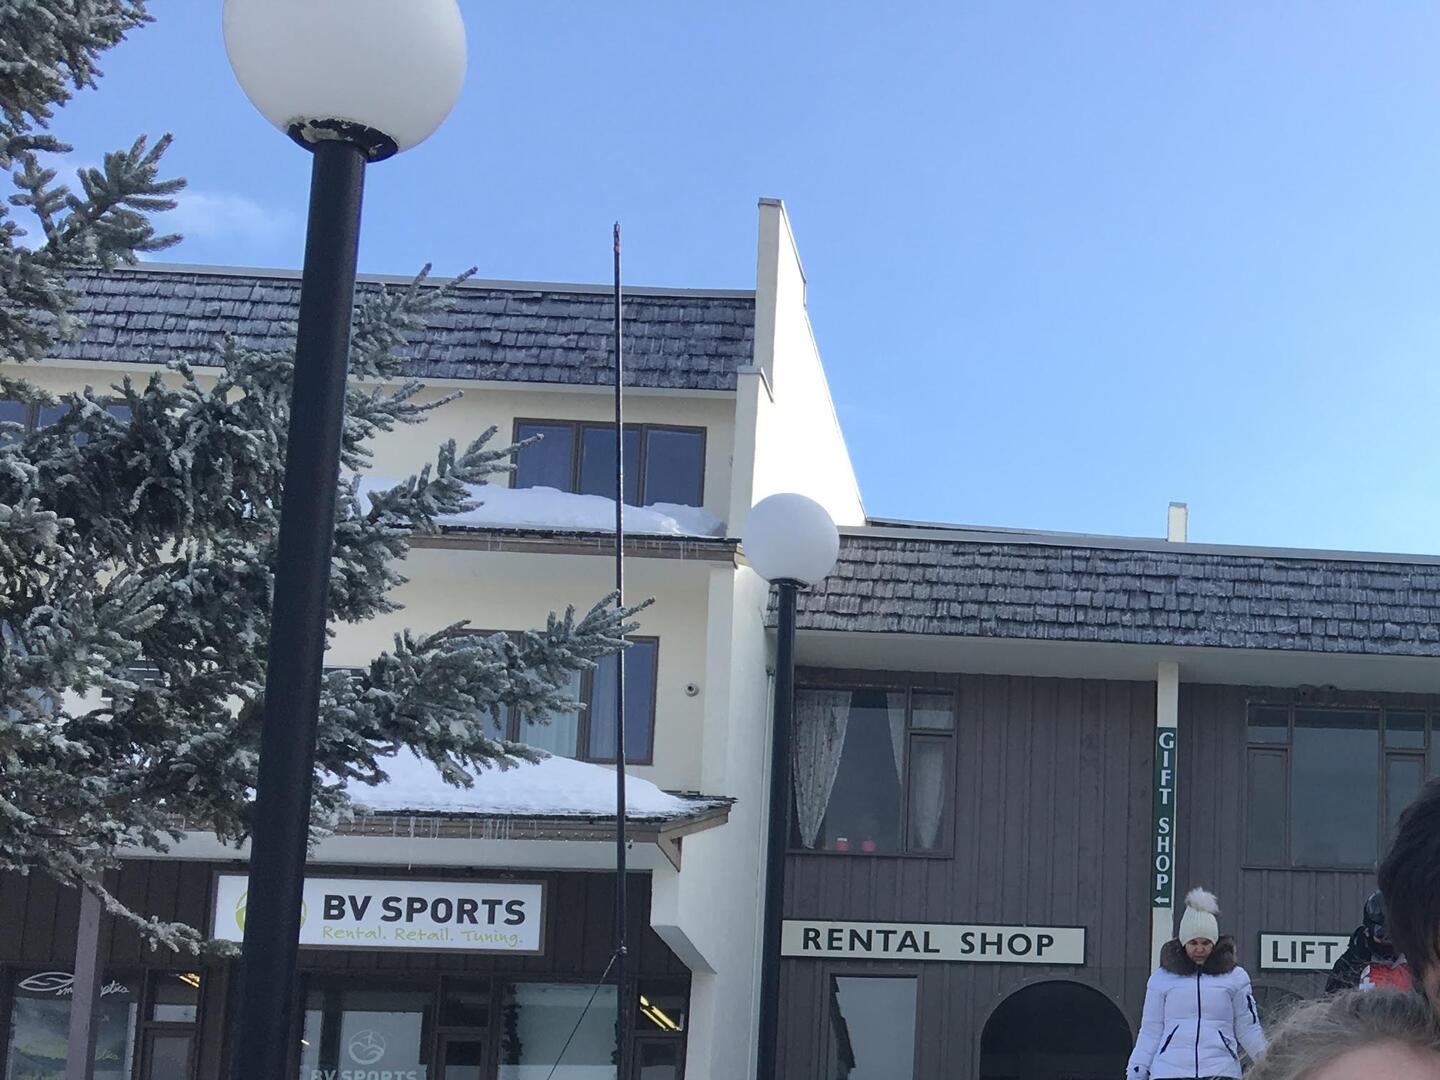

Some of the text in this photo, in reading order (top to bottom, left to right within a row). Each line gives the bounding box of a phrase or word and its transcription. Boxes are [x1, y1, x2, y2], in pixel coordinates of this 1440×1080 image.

[1155, 732, 1175, 890] GIFT SHOP
[323, 894, 526, 926] BV SPORTS
[322, 926, 524, 948] Rental. Retail. Tuning.
[802, 927, 1055, 957] RENTAL SHOP
[1272, 940, 1339, 964] LIFT
